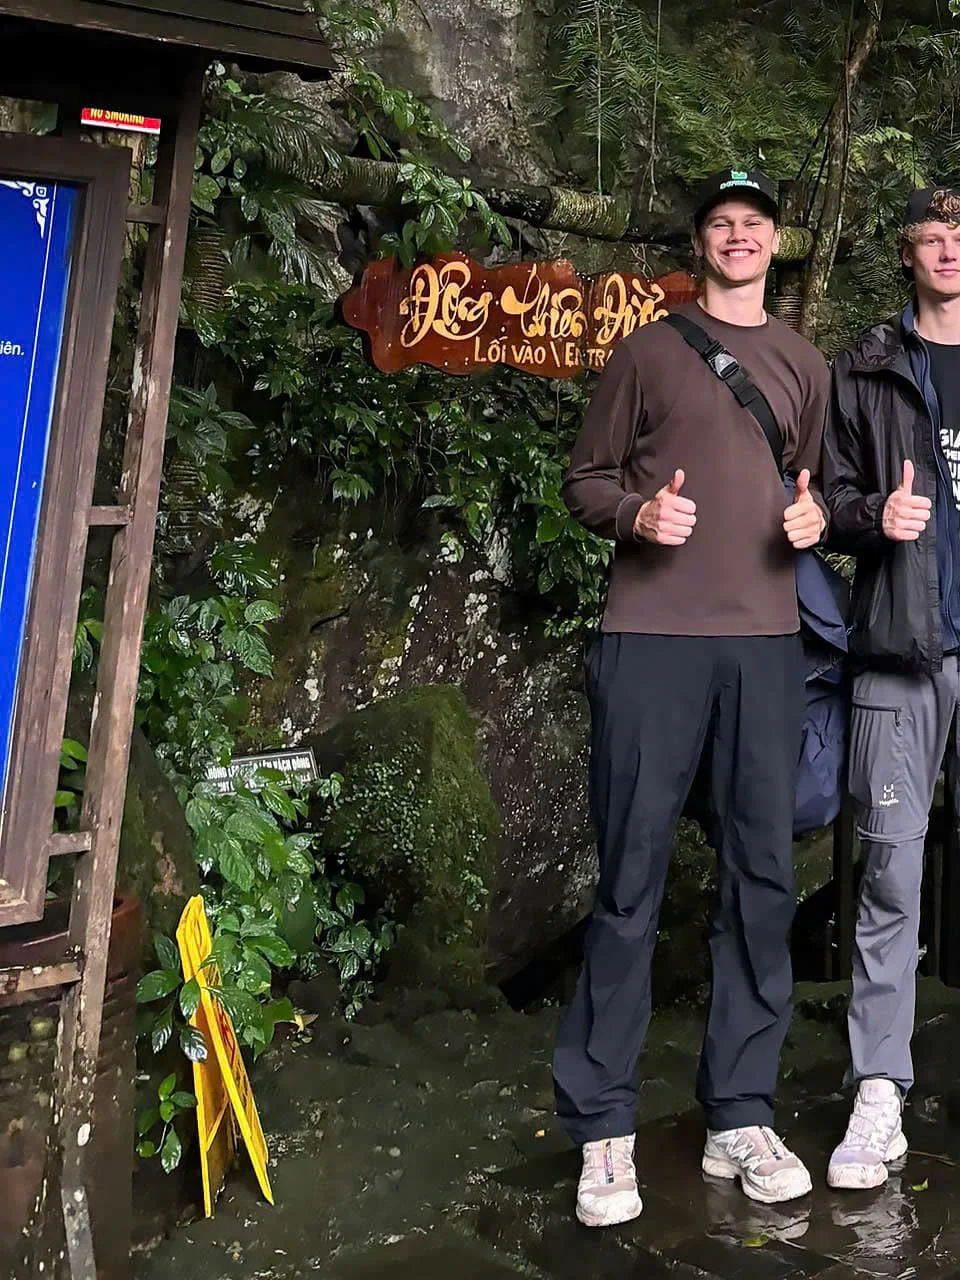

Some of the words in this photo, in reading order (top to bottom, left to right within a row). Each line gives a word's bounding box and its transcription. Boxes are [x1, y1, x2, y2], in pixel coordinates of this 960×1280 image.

[0, 340, 25, 356] iên.
[474, 336, 508, 363] LỐI
[511, 339, 547, 365] VÀO
